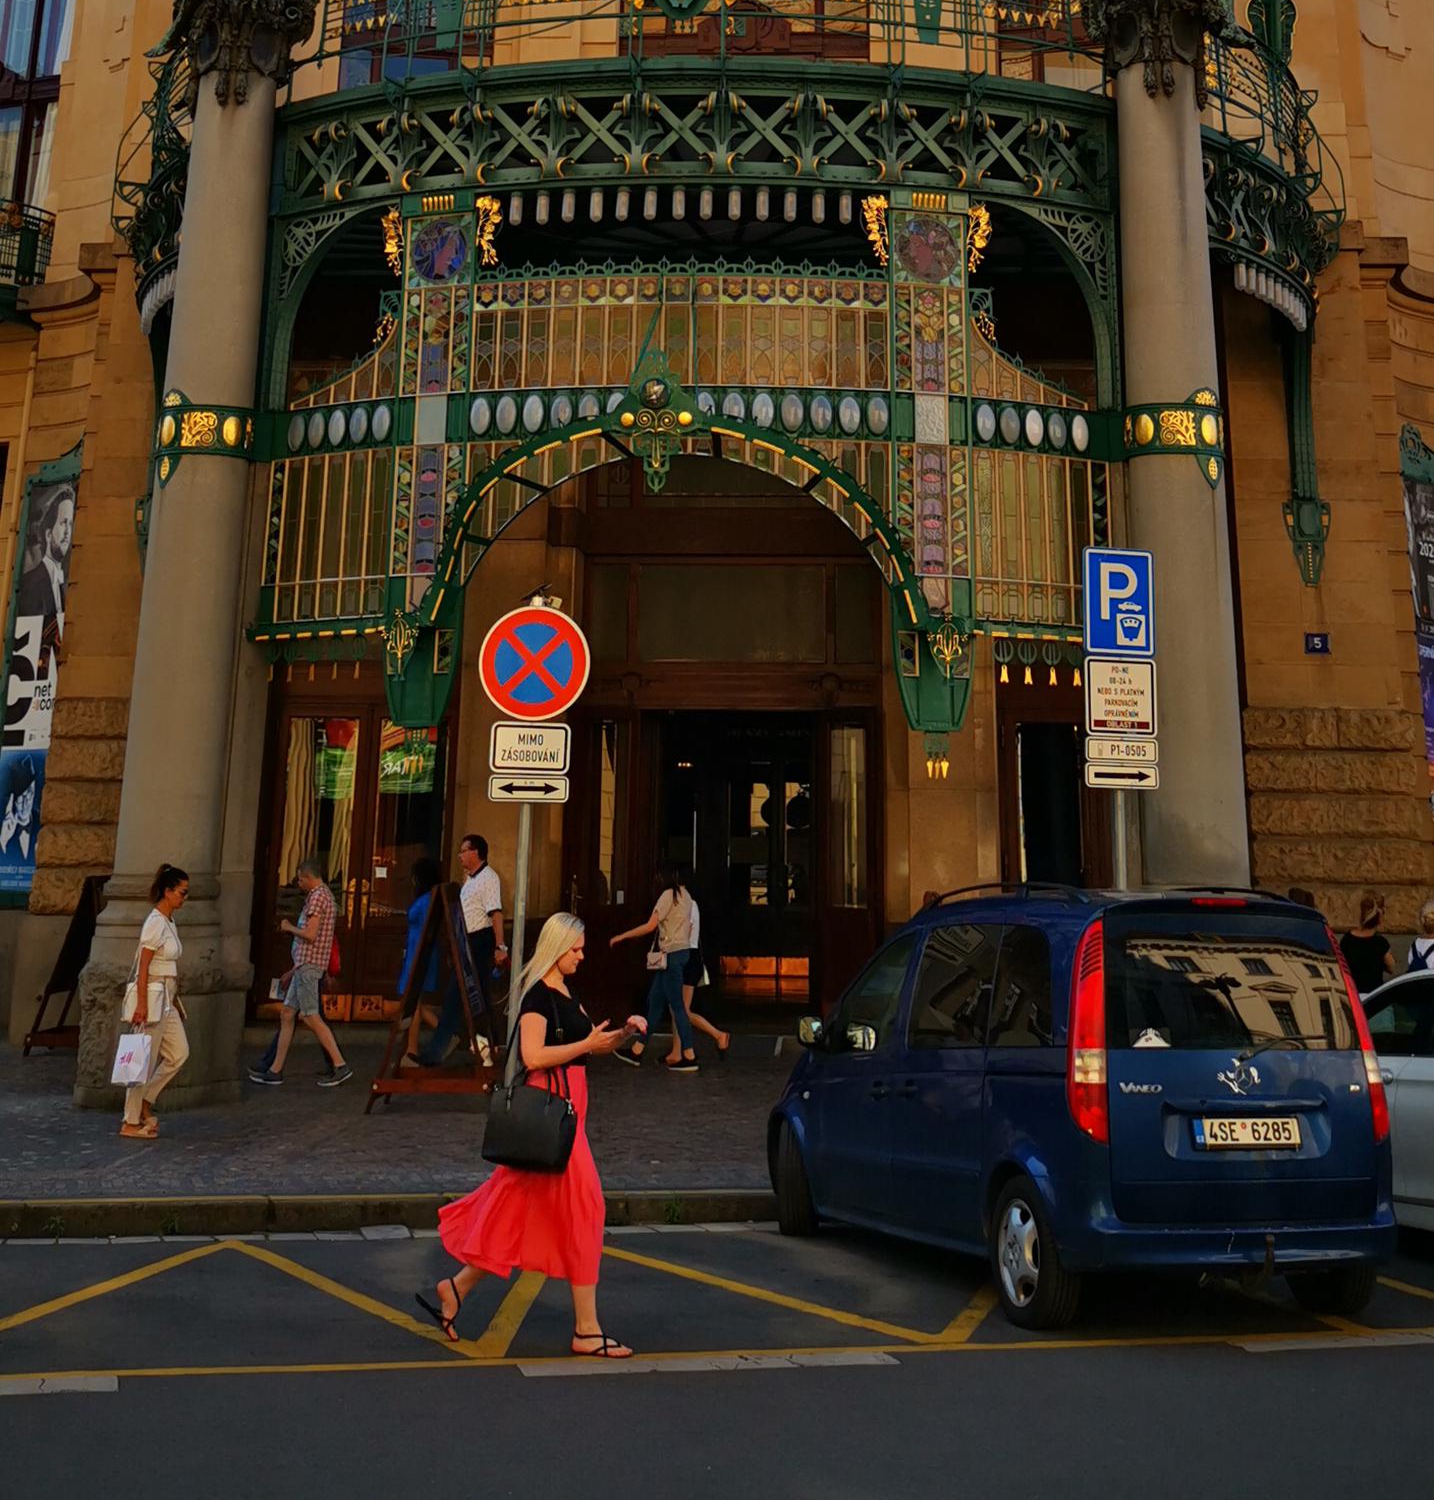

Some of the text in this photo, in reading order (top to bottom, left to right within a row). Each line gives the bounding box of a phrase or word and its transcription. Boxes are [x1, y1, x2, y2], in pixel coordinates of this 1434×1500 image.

[1100, 562, 1138, 621] P
[1313, 637, 1322, 649] 5
[34, 681, 52, 698] net
[1097, 687, 1112, 695] NEBO
[518, 733, 544, 746] MIMO
[501, 746, 560, 763] ZÁSOBOVÁNÍ
[1110, 744, 1147, 757] P1-0505
[1209, 1120, 1292, 1142] 4SE 6285
